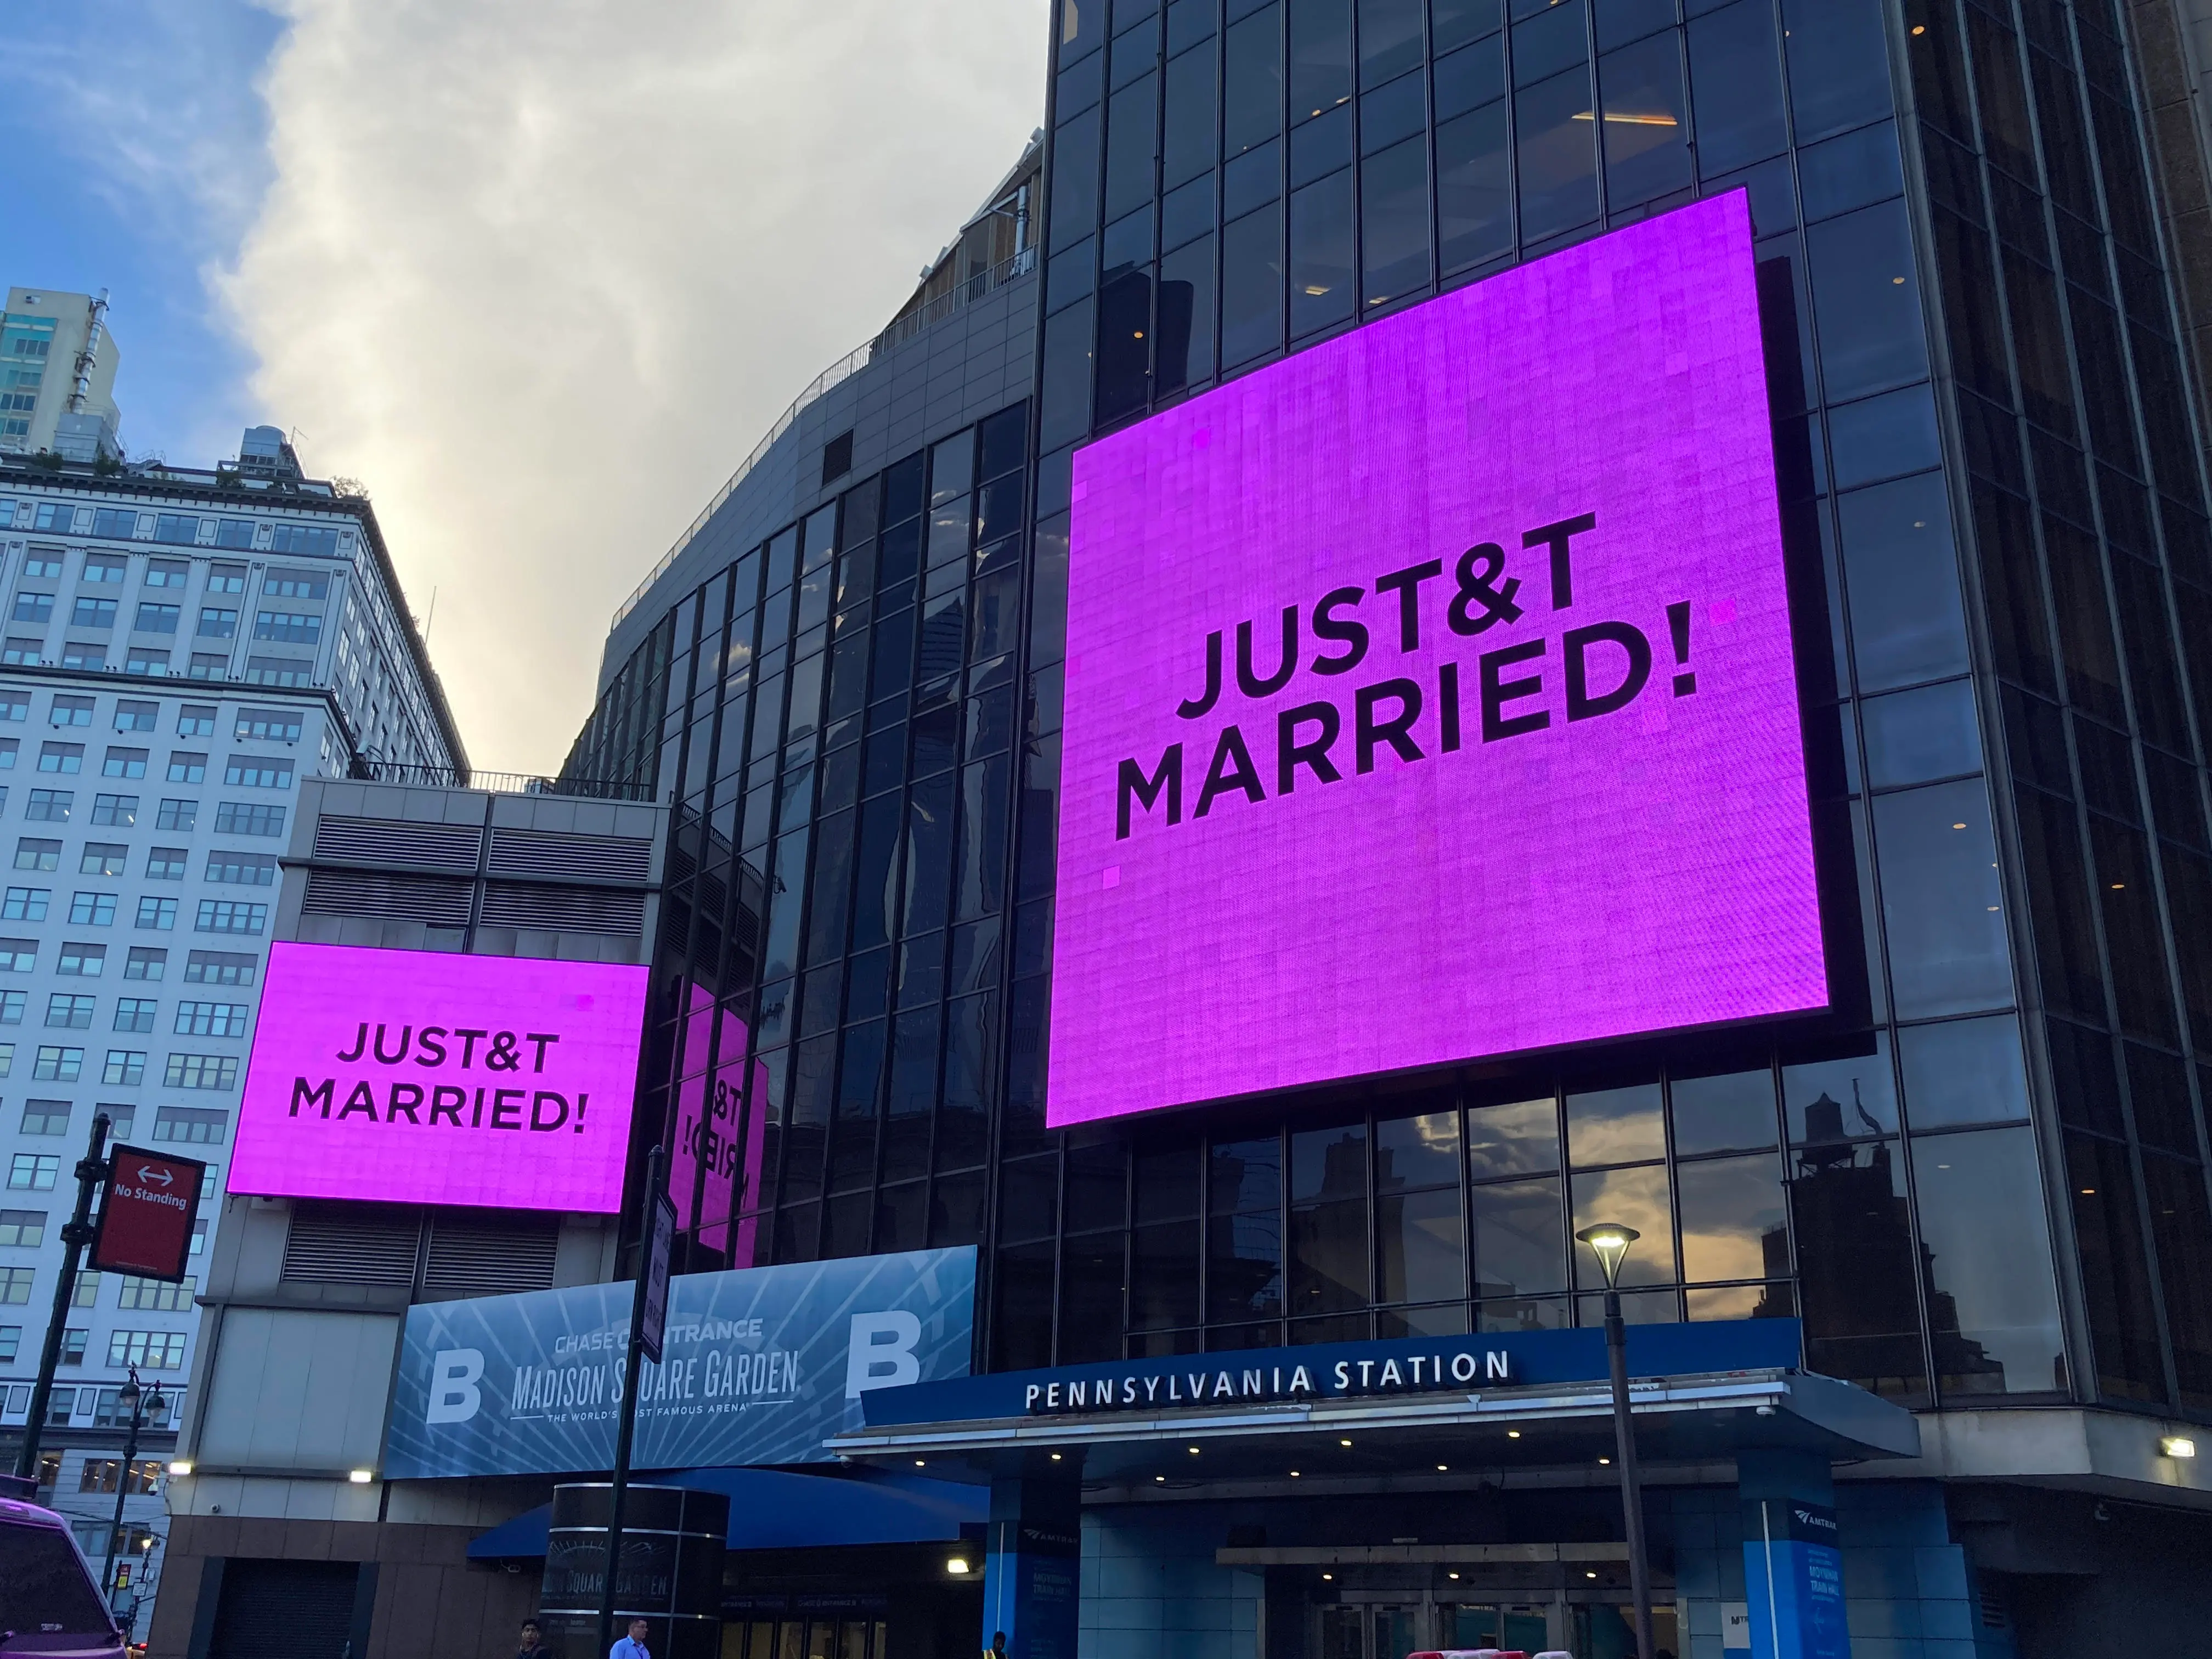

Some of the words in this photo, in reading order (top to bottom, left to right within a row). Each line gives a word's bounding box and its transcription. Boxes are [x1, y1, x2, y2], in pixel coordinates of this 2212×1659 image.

[1175, 511, 1595, 720] JUST&T
[1116, 600, 1696, 841] MARRIED!
[336, 1022, 560, 1073] JUST&T
[289, 1076, 589, 1134] MARRIED!
[115, 1184, 132, 1197] No
[134, 1188, 187, 1210] Standing
[555, 1332, 614, 1353] CHASE
[845, 1310, 921, 1398] B
[426, 1348, 485, 1424] B
[511, 1365, 605, 1409] MADISON
[611, 1357, 697, 1403] SUARE
[704, 1350, 798, 1398] GARDEN
[1025, 1365, 1311, 1408] PENNSYLVANIA
[1335, 1350, 1508, 1389] STATION
[548, 1414, 567, 1423] THE
[571, 1410, 618, 1421] WORLD'S
[657, 1406, 703, 1417] FAMOUS
[708, 1403, 747, 1413] ARENA
[567, 1570, 603, 1594] SQUAR
